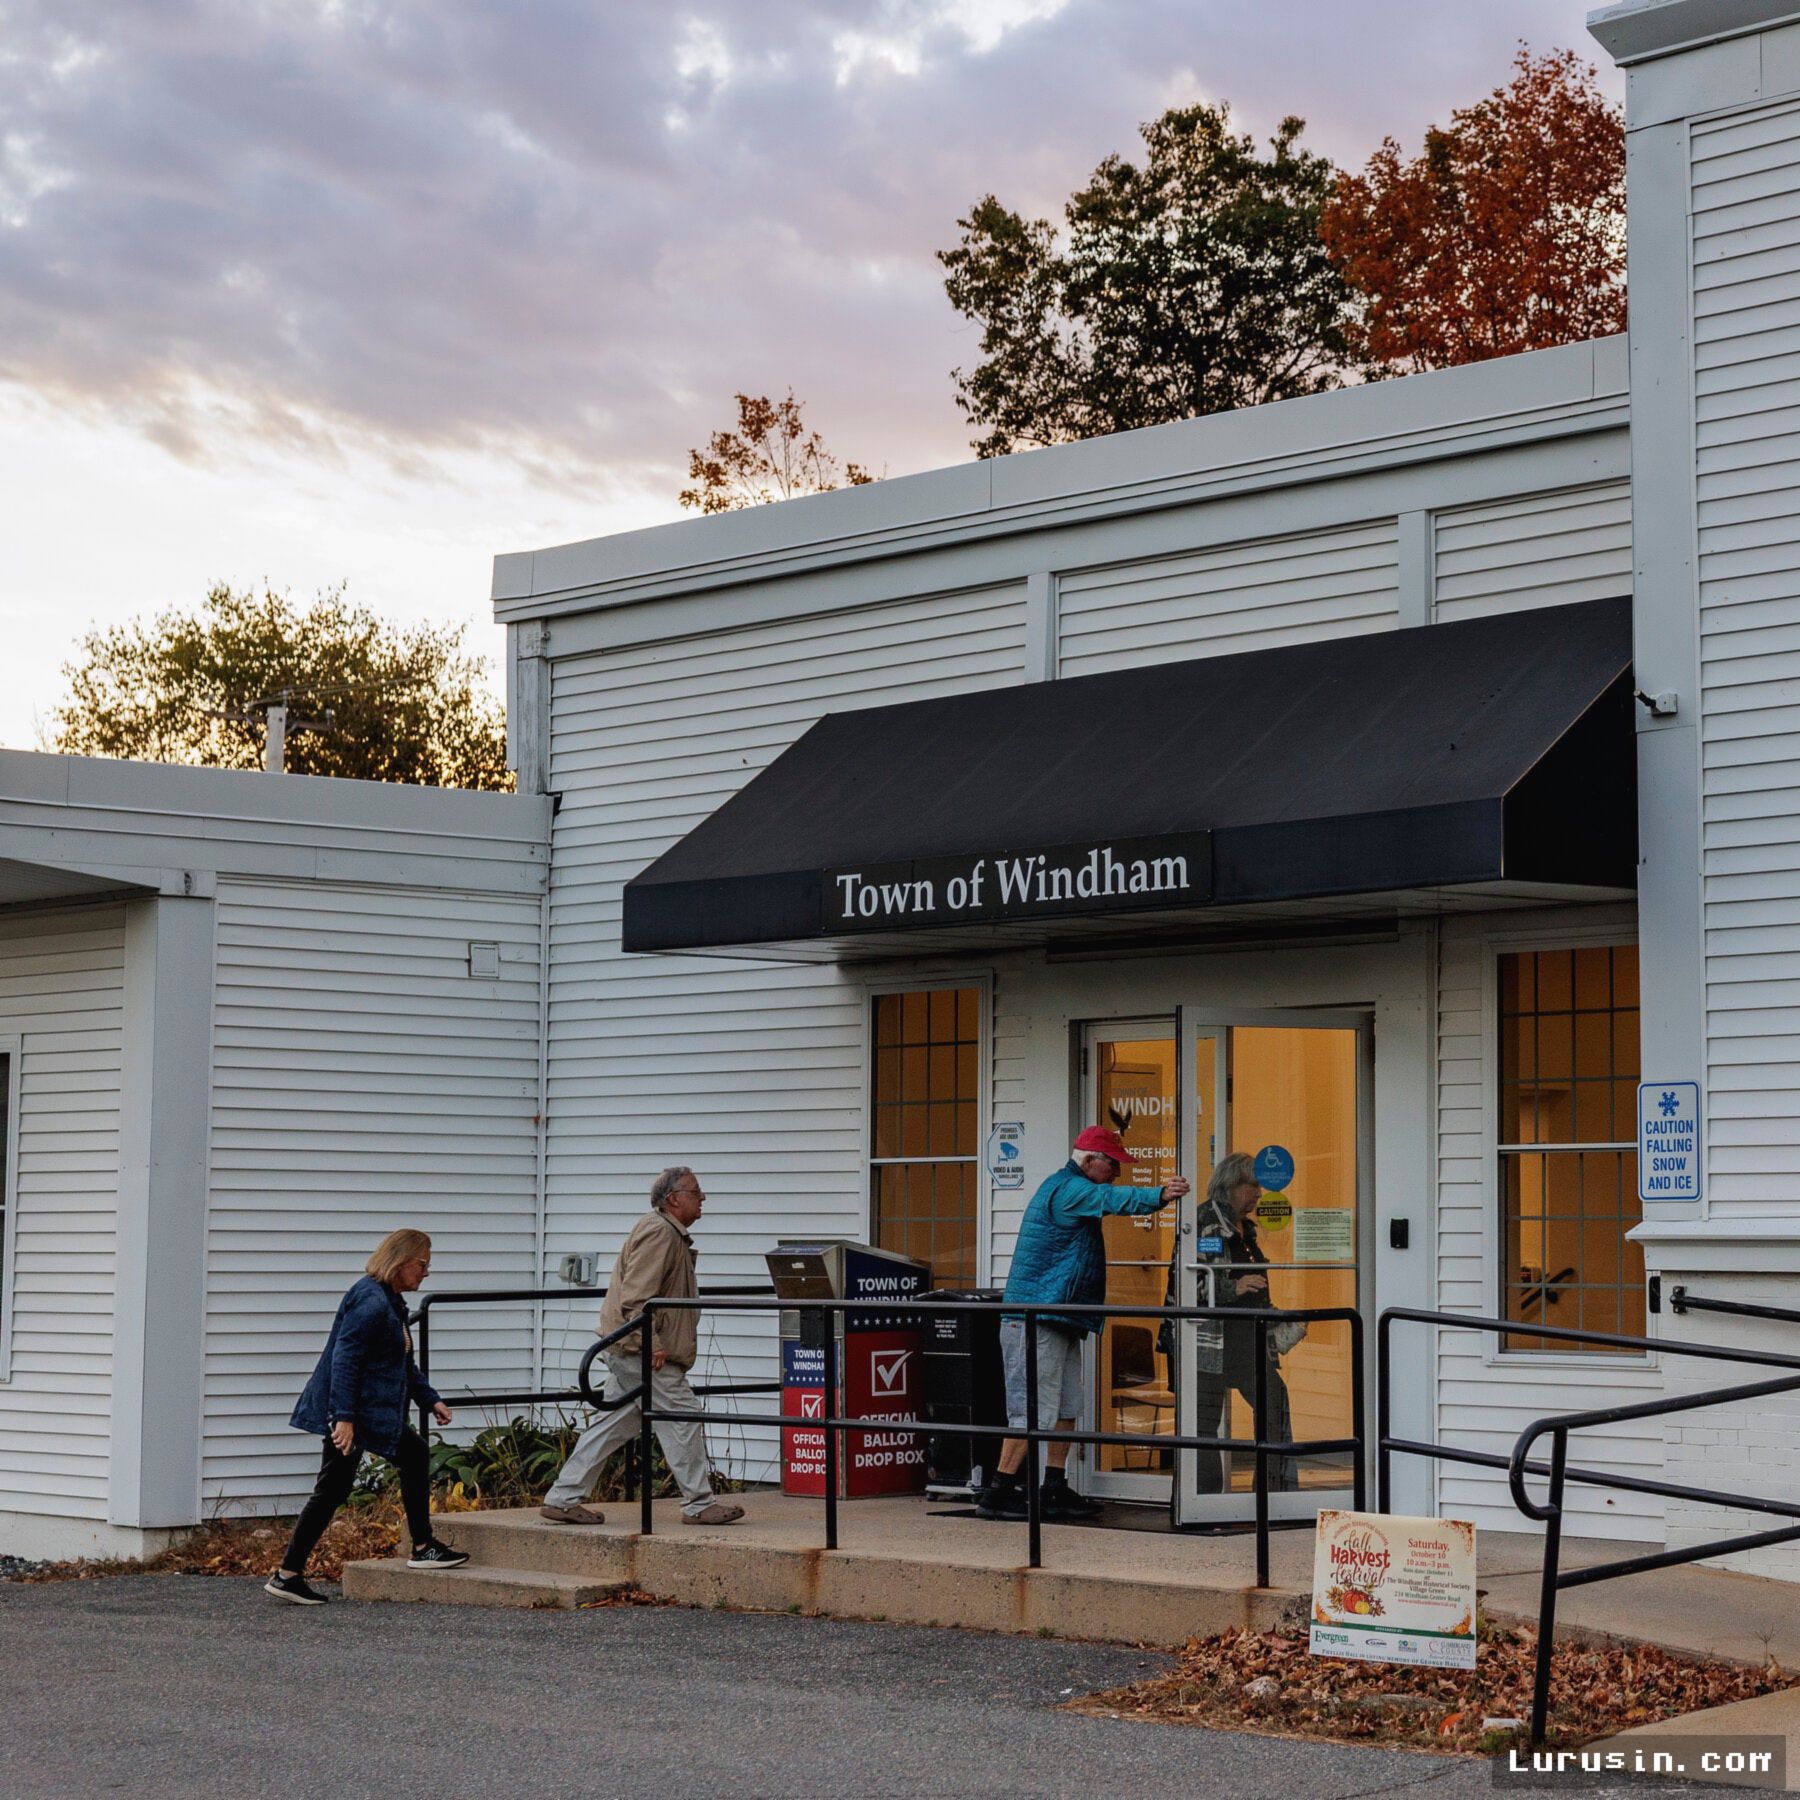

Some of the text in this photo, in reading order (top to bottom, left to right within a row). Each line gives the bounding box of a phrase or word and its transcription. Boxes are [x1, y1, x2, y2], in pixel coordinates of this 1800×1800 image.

[837, 847, 1191, 918] Town of Windham
[1111, 1096, 1202, 1117] WINDH
[1645, 1120, 1694, 1135] CAUTION
[1646, 1138, 1693, 1153] FALLING
[1155, 1148, 1176, 1159] HOU
[1132, 1167, 1152, 1175] Monday
[1653, 1157, 1686, 1171] SNOW
[1132, 1176, 1152, 1184] Tuesday
[1648, 1175, 1692, 1190] AND ICE
[1134, 1220, 1152, 1229] Sunday
[857, 1276, 918, 1292] TOWN OF
[794, 1349, 825, 1359] TOWN O
[793, 1433, 825, 1445] OFFICIA
[863, 1432, 915, 1448] BALLOT
[855, 1450, 925, 1468] DROP BOX
[790, 1463, 826, 1475] DROP BO
[1408, 1538, 1450, 1552] Saturday,
[1411, 1550, 1436, 1559] October
[1398, 1578, 1422, 1586] Windham
[1450, 1582, 1471, 1592] Society
[1410, 1585, 1427, 1594] Village
[1315, 1630, 1349, 1645] Evergreen
